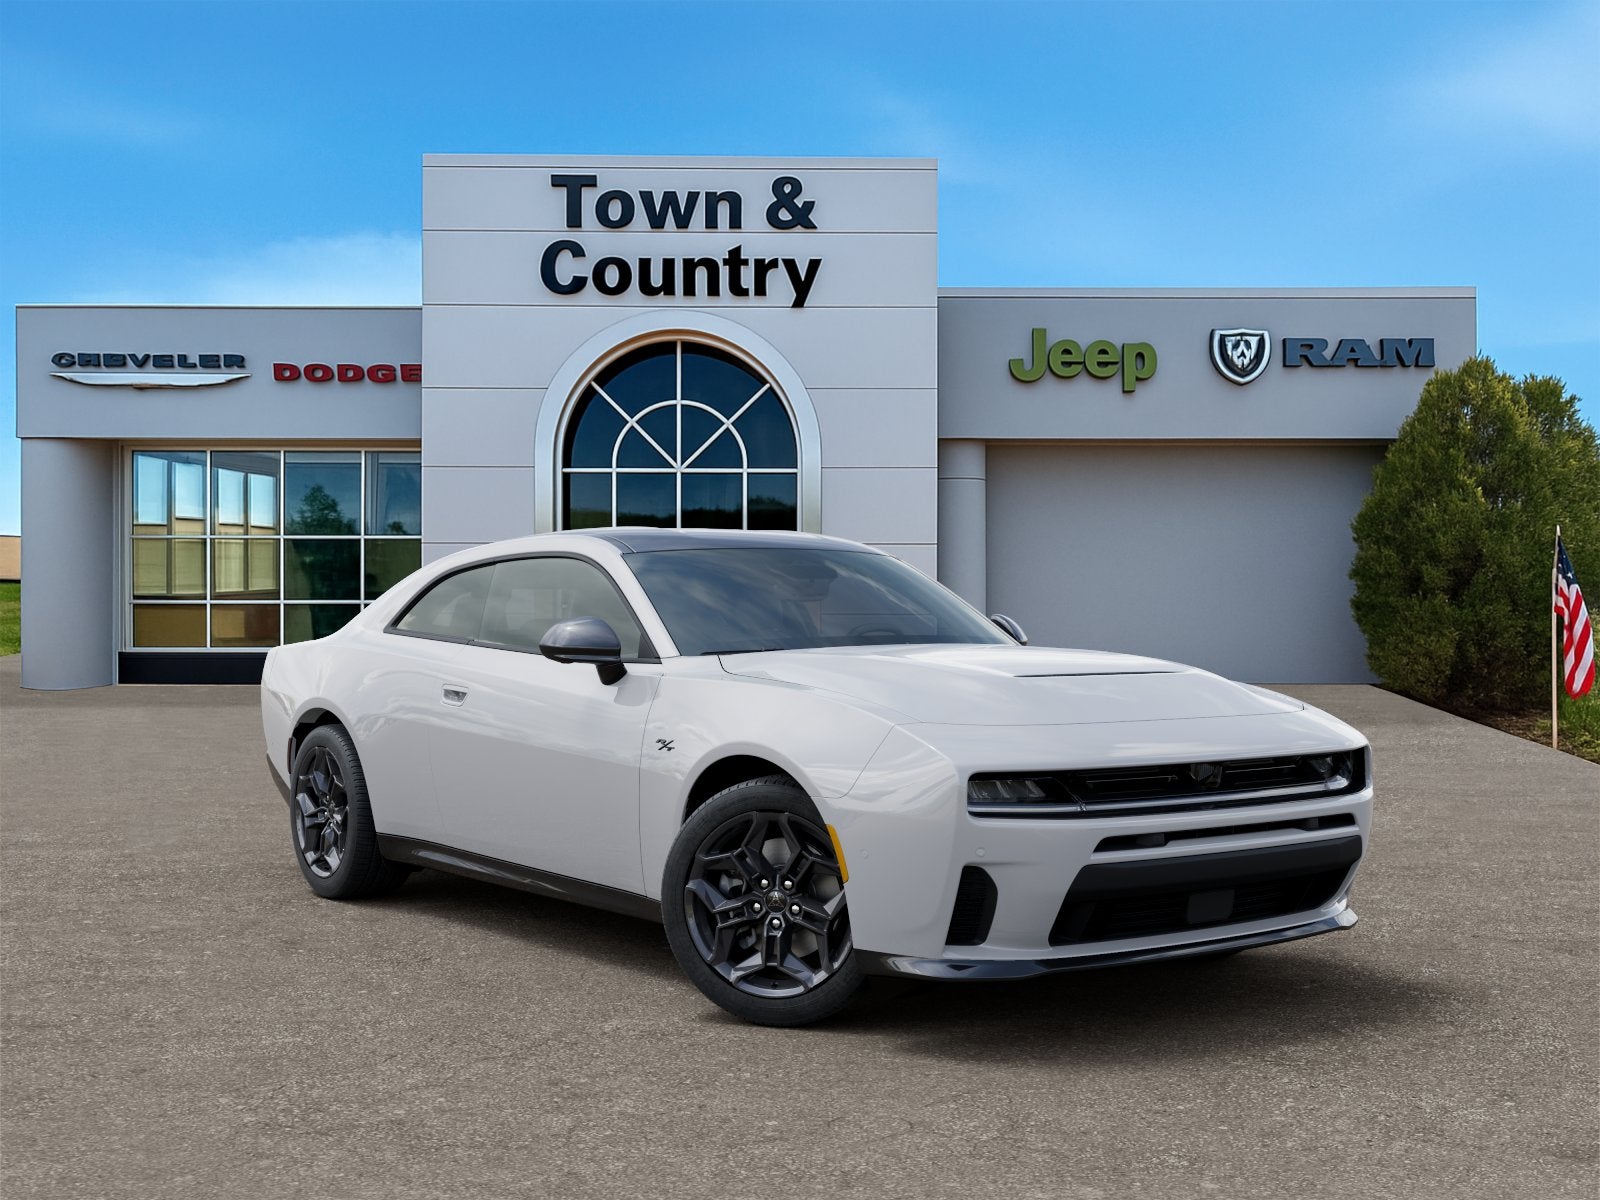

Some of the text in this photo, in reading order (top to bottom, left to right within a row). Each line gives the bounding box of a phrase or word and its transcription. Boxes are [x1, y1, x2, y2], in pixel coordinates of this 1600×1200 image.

[551, 174, 818, 230] Town &
[540, 239, 822, 308] Country
[273, 363, 422, 383] DODGE
[1009, 328, 1157, 392] Jeep
[1283, 338, 1435, 368] RAM
